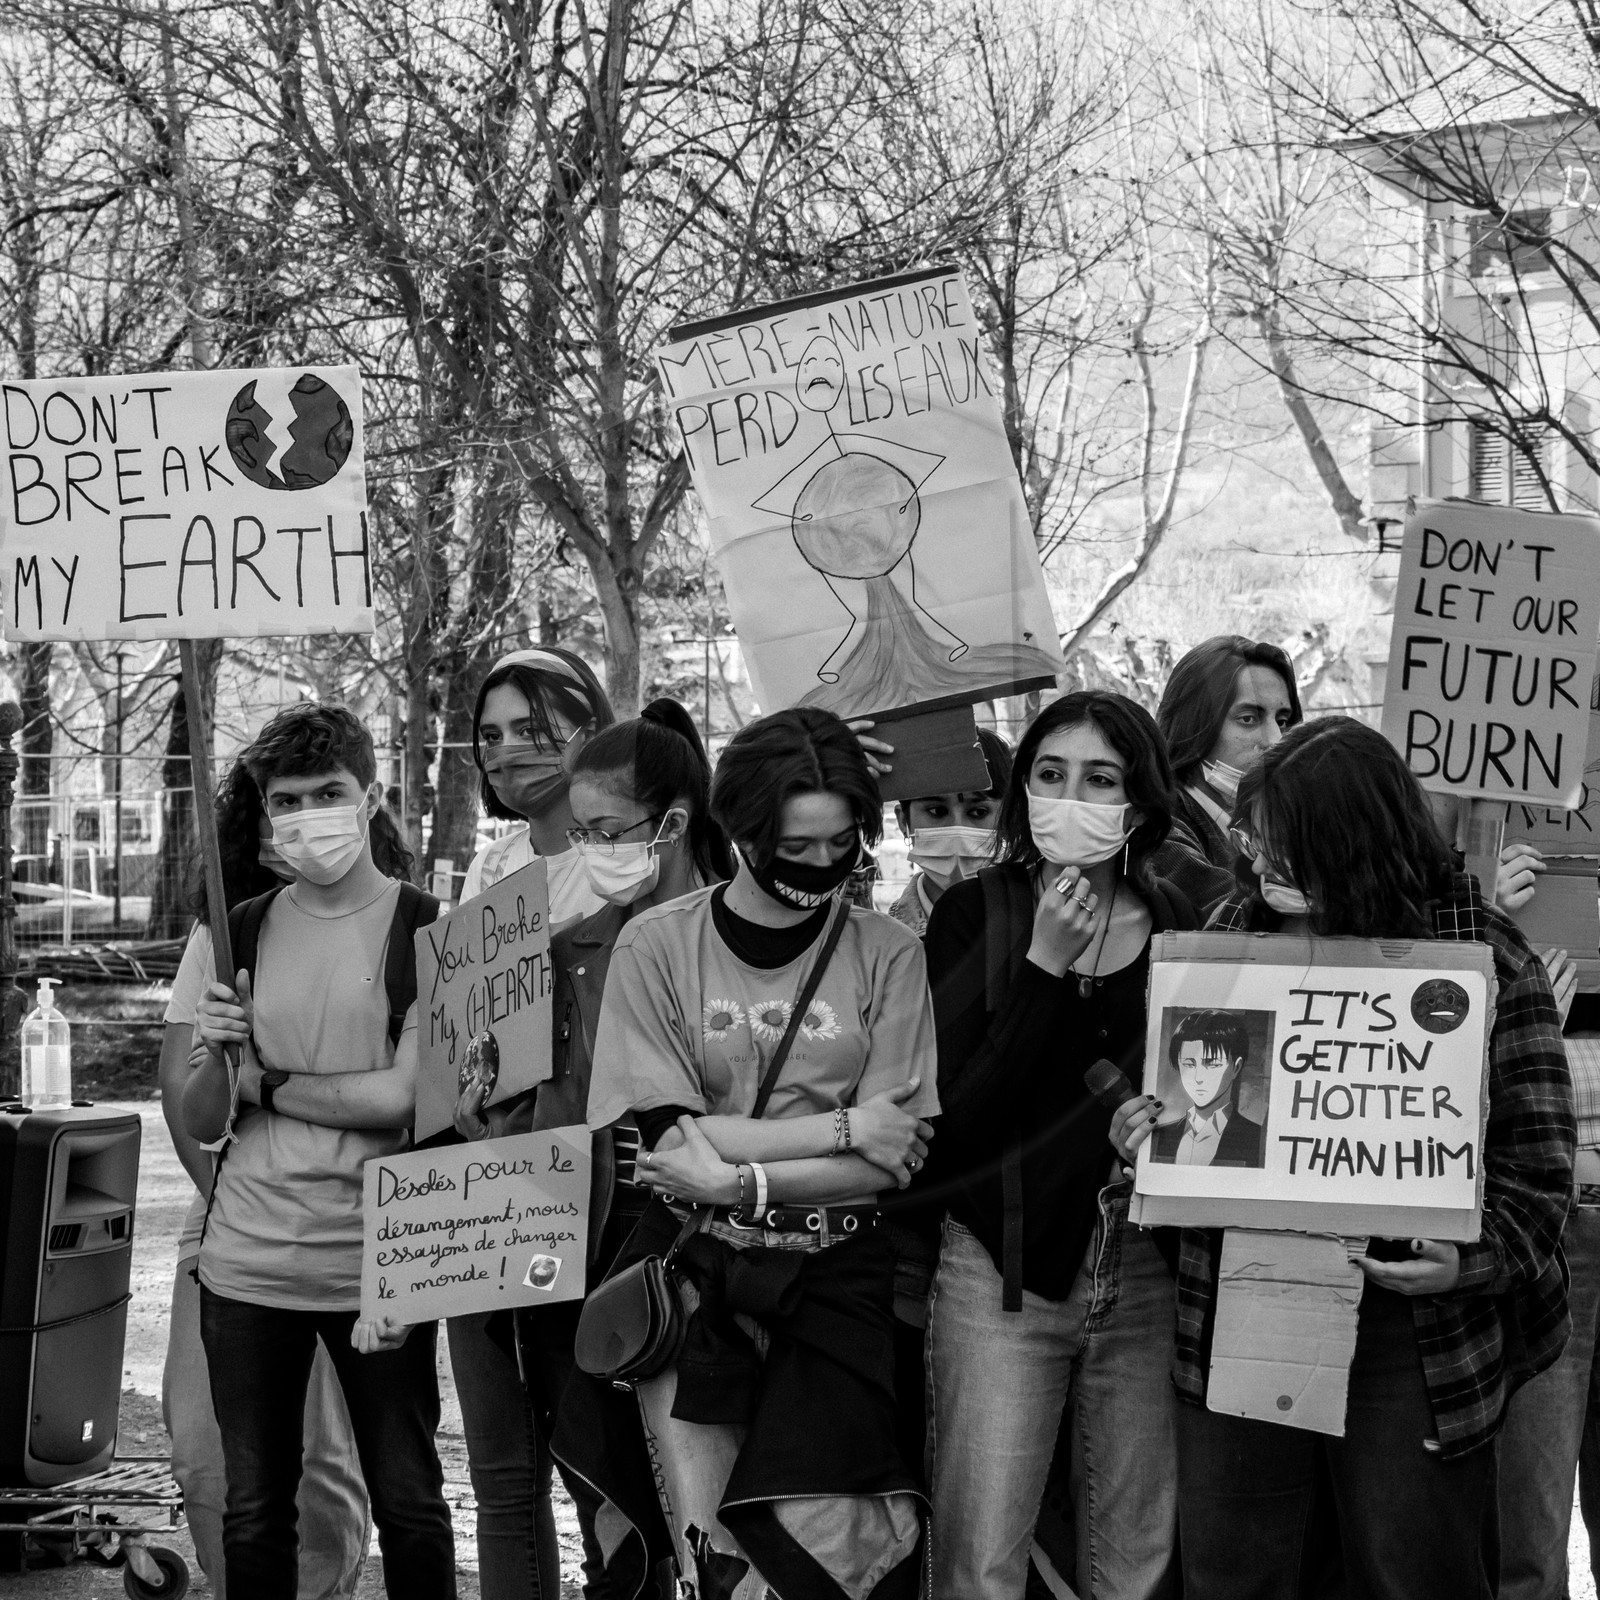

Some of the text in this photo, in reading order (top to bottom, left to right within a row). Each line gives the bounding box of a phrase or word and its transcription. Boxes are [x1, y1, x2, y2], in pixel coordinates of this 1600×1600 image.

[2, 385, 172, 449] DON'T
[676, 390, 799, 470] PERD
[9, 445, 234, 525] BREAK
[15, 511, 372, 630] MY EARTH
[1420, 528, 1555, 582] DON'T
[1414, 577, 1578, 635] LET OUR
[1402, 636, 1579, 710] FUTUR
[1406, 709, 1563, 791] BURN
[428, 894, 542, 1004] You Broke
[430, 1003, 459, 1065] My
[1289, 989, 1397, 1031] IT'S
[1291, 1080, 1463, 1120] HOTTER
[378, 1145, 574, 1207] Désolés pour le
[1279, 1136, 1387, 1176] THAN
[526, 1201, 579, 1218] nous
[377, 1229, 577, 1268] essayons de changer
[378, 1276, 397, 1300] le
[410, 1264, 490, 1293] monde
